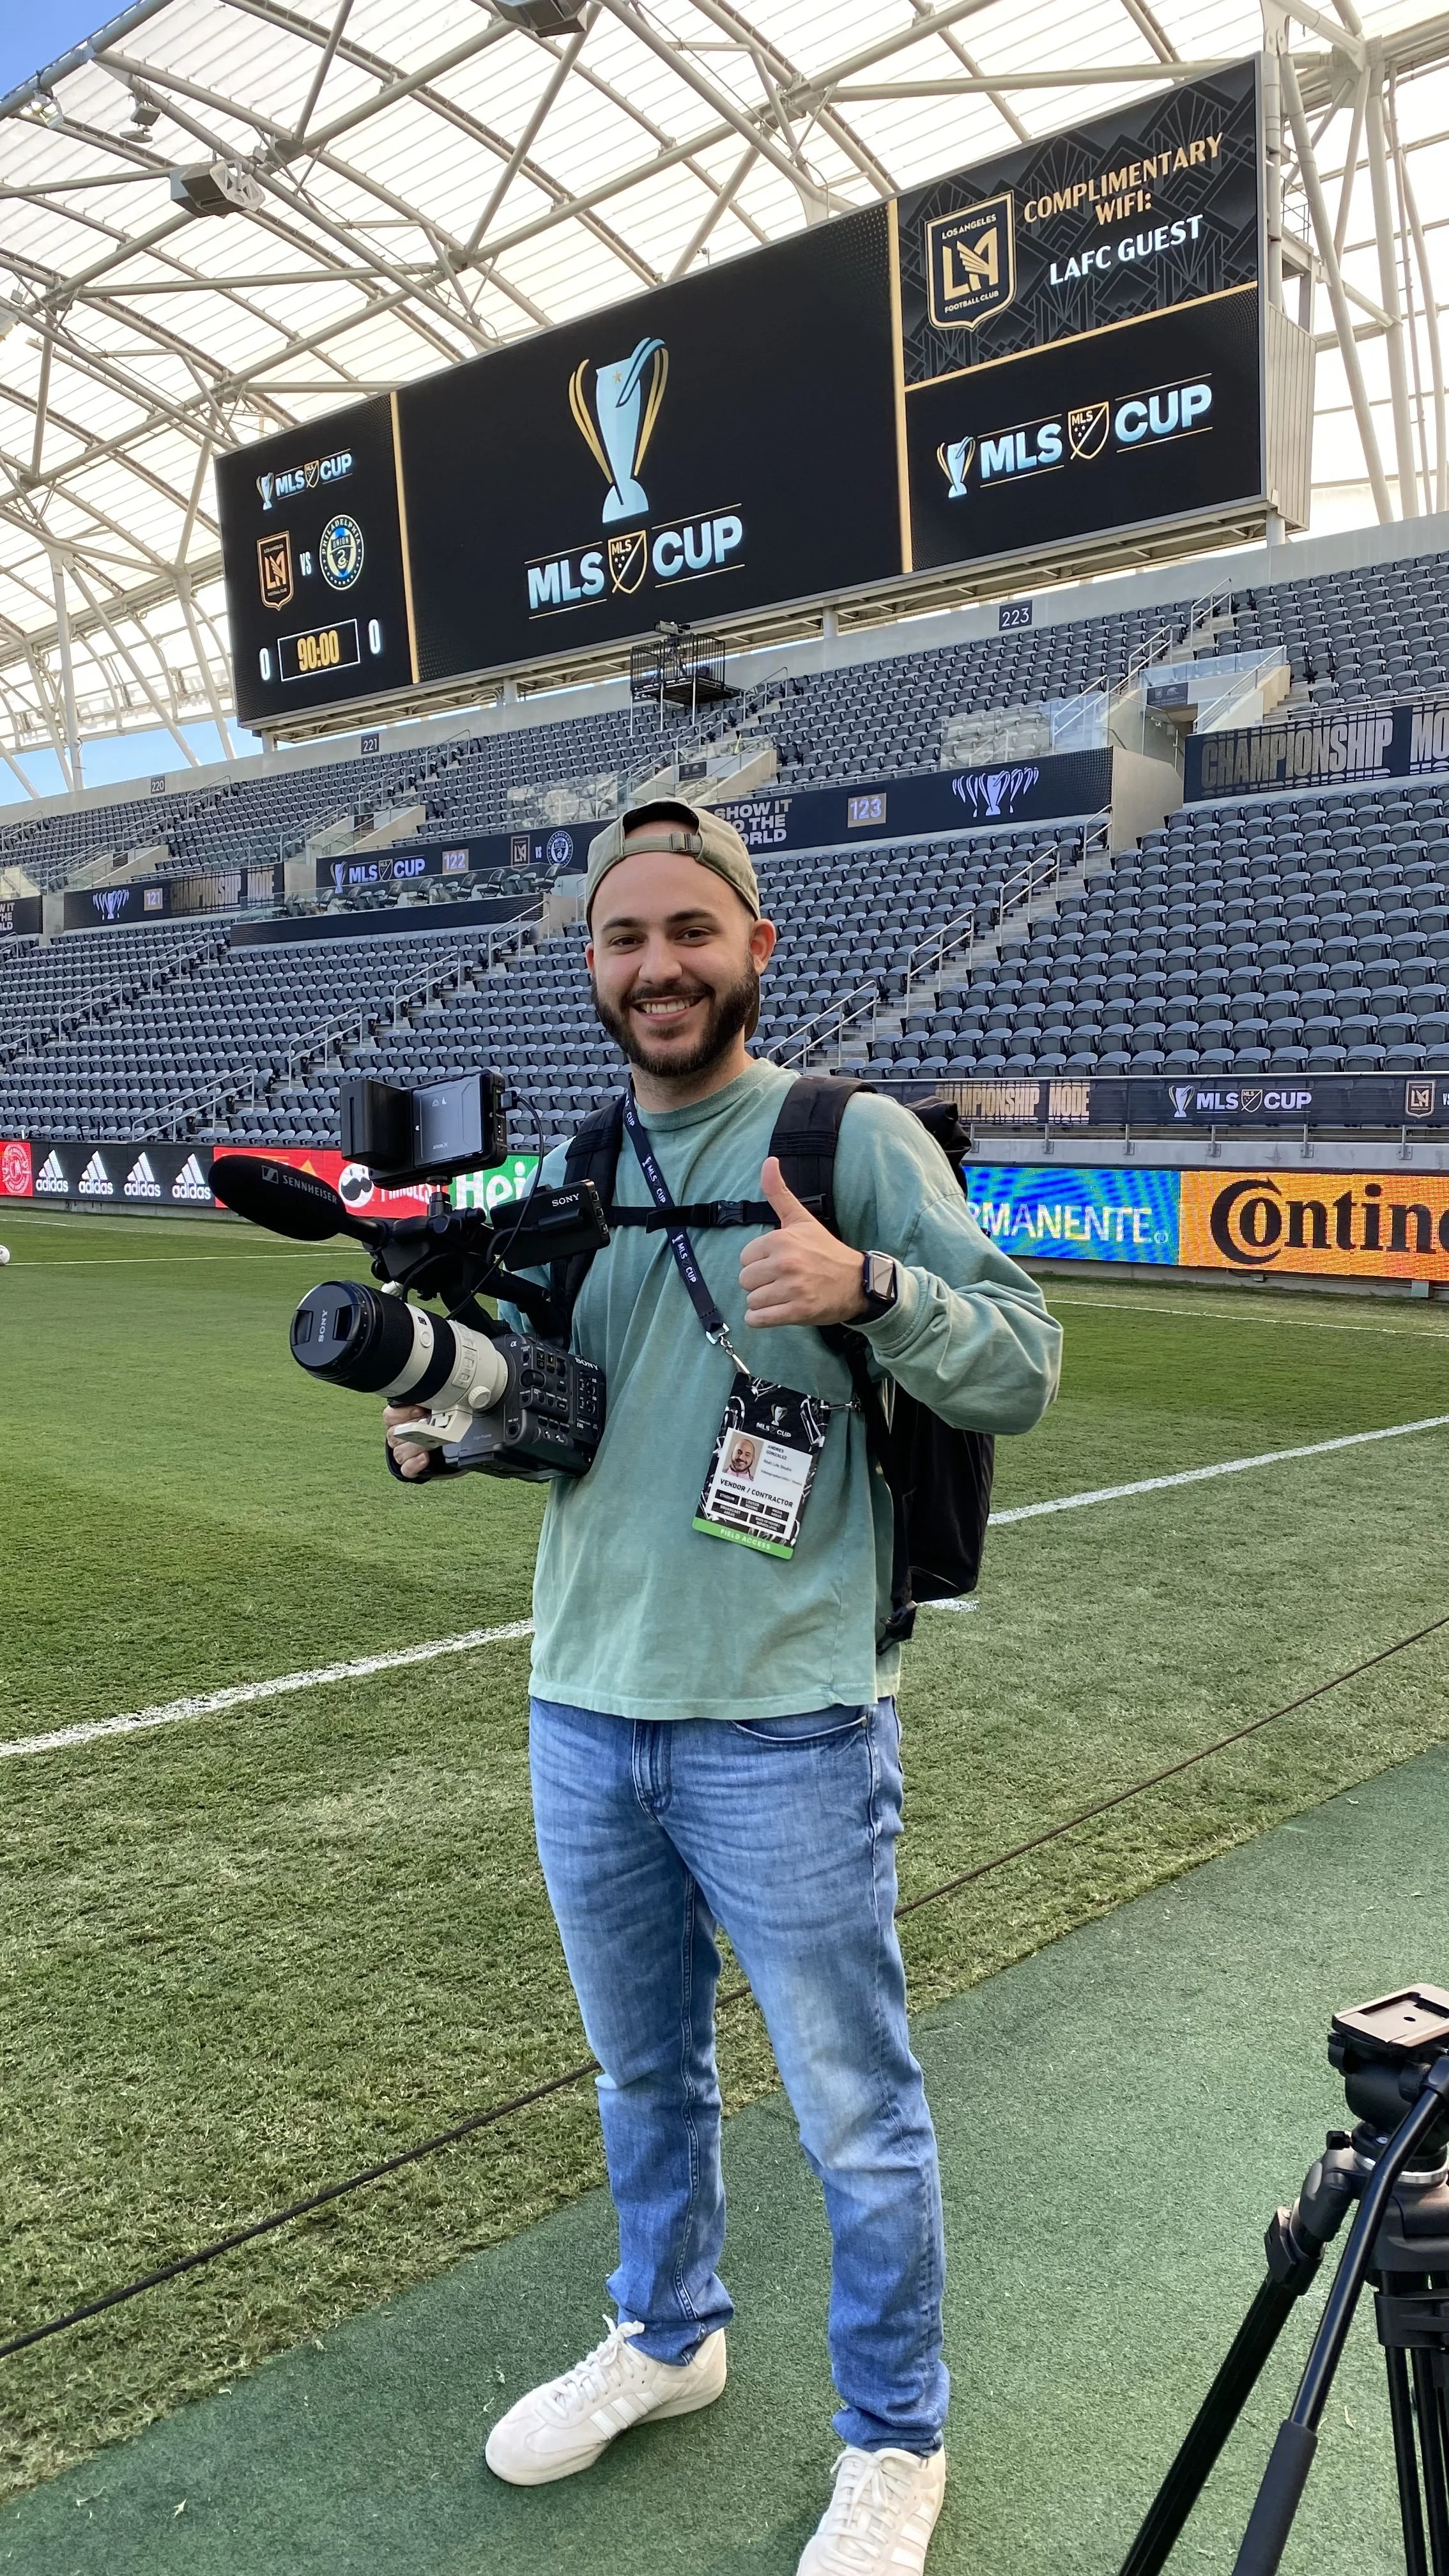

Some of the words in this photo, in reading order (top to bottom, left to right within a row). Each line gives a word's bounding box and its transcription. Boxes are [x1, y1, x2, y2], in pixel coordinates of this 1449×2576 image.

[1024, 132, 1223, 224] COMPLIMENTARY
[1095, 189, 1152, 225] WIFI:
[942, 228, 958, 240] LOS
[958, 213, 997, 234] ANGELES
[1050, 245, 1111, 285] LAFC
[1117, 215, 1203, 263] GUEST
[944, 296, 979, 313] FOOTBALL
[979, 290, 999, 303] CLUB
[980, 424, 1062, 479] MLS
[1116, 384, 1213, 442] CUP
[275, 470, 305, 496] MLS
[320, 453, 352, 480] CUP
[300, 551, 311, 576] VS
[528, 552, 605, 609] MLS
[611, 539, 632, 556] MLS
[652, 516, 742, 576] CUP
[1002, 608, 1030, 627] 223
[259, 647, 270, 680] 0
[297, 630, 340, 671] 90:00
[369, 619, 381, 654] 0
[363, 739, 377, 752] 221
[1202, 714, 1393, 792] CHAMPIONSHIP
[151, 779, 164, 792] 220
[714, 801, 770, 820] SHOW
[775, 799, 793, 813] IT
[850, 797, 882, 820] 123
[727, 819, 745, 831] O
[749, 813, 786, 831] THE
[741, 829, 787, 845] ORLD
[349, 864, 378, 884] MLS
[394, 859, 425, 878] CUP
[444, 852, 466, 870] 122
[146, 891, 160, 905] 121
[0, 912, 13, 922] HE
[1048, 1084, 1091, 1119] MODE
[1197, 1092, 1239, 1110] MLS
[1264, 1092, 1312, 1110] CUP
[626, 1111, 635, 1127] CUP
[36, 1177, 69, 1193] adidas
[79, 1179, 114, 1195] adidas
[124, 1179, 161, 1197] adidas
[172, 1182, 212, 1200] adidas
[282, 1175, 337, 1205] SENNHEISER
[647, 1165, 657, 1183] MLS
[656, 1187, 666, 1204] CUP
[551, 1193, 579, 1207] SONY
[1211, 1177, 1449, 1265] Contin
[677, 1242, 688, 1260] MLS
[686, 1266, 697, 1284] CUP
[318, 1309, 328, 1342] SONY
[575, 1357, 599, 1370] SONY
[756, 1422, 770, 1431] MLS
[776, 1429, 792, 1438] CUP
[720, 1478, 746, 1491] VENDOR
[751, 1489, 793, 1507] CONTRACTOR
[720, 1529, 740, 1540] FIELD
[741, 1537, 771, 1550] ACCESS
